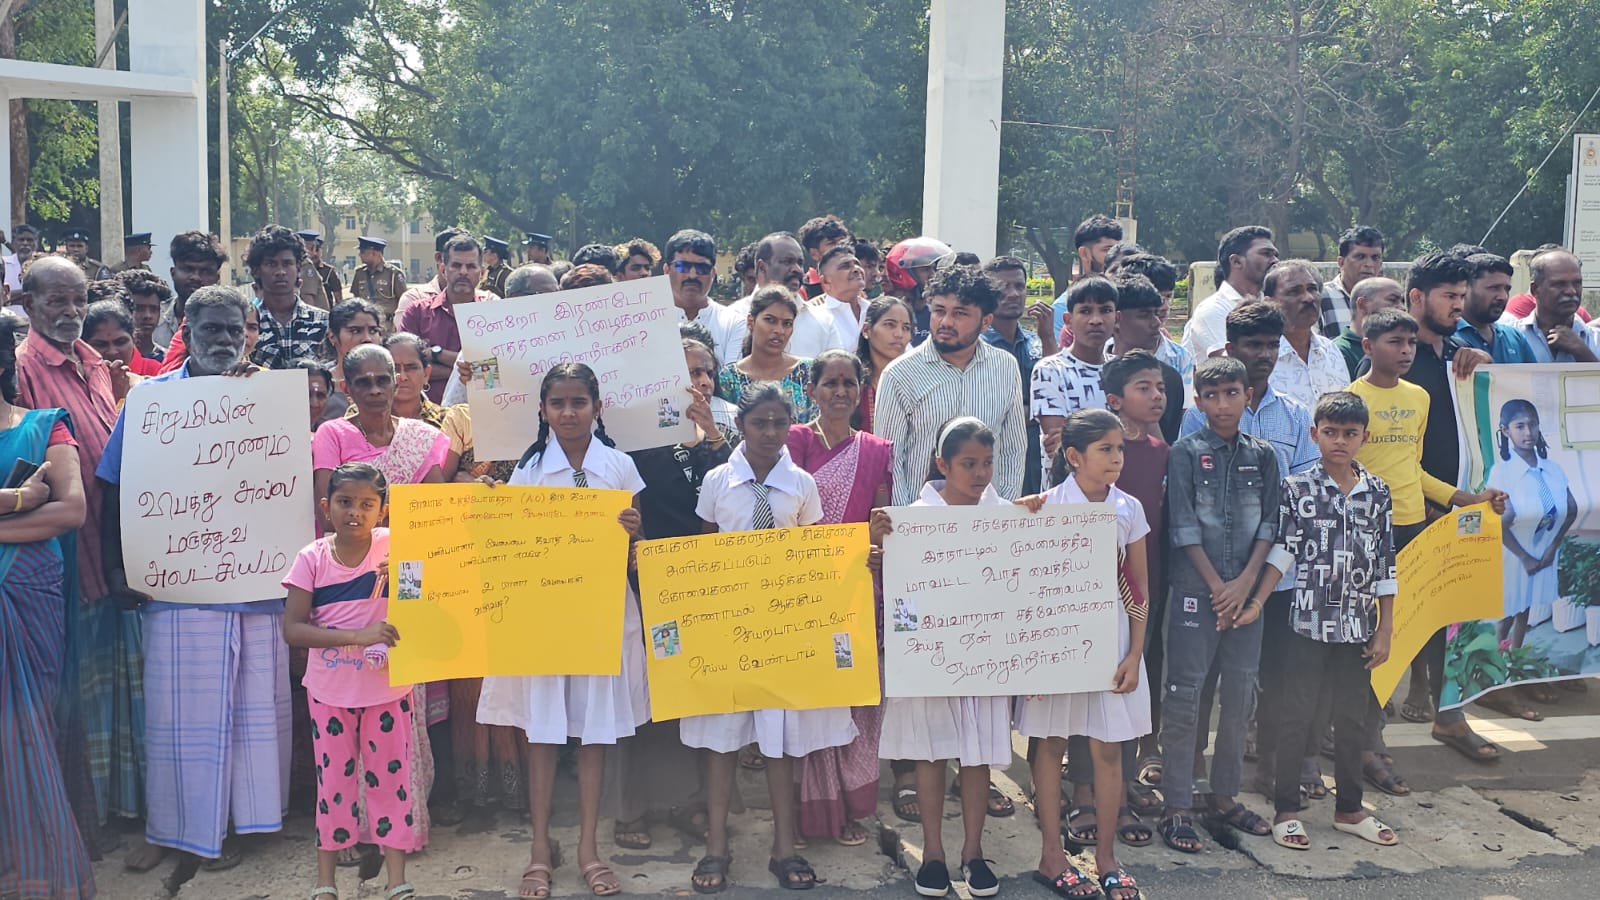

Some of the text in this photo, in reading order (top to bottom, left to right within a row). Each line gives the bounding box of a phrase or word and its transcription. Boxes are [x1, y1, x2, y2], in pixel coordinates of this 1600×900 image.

[142, 396, 255, 444] சிறுமியின்
[493, 392, 528, 410] ஏன்
[193, 427, 290, 469] மரணம்
[138, 476, 296, 522] விபத்து அல்ல
[145, 546, 286, 587] அலட்சியம்
[738, 646, 816, 672] வேண்டாம்
[960, 630, 992, 650] ஏன்
